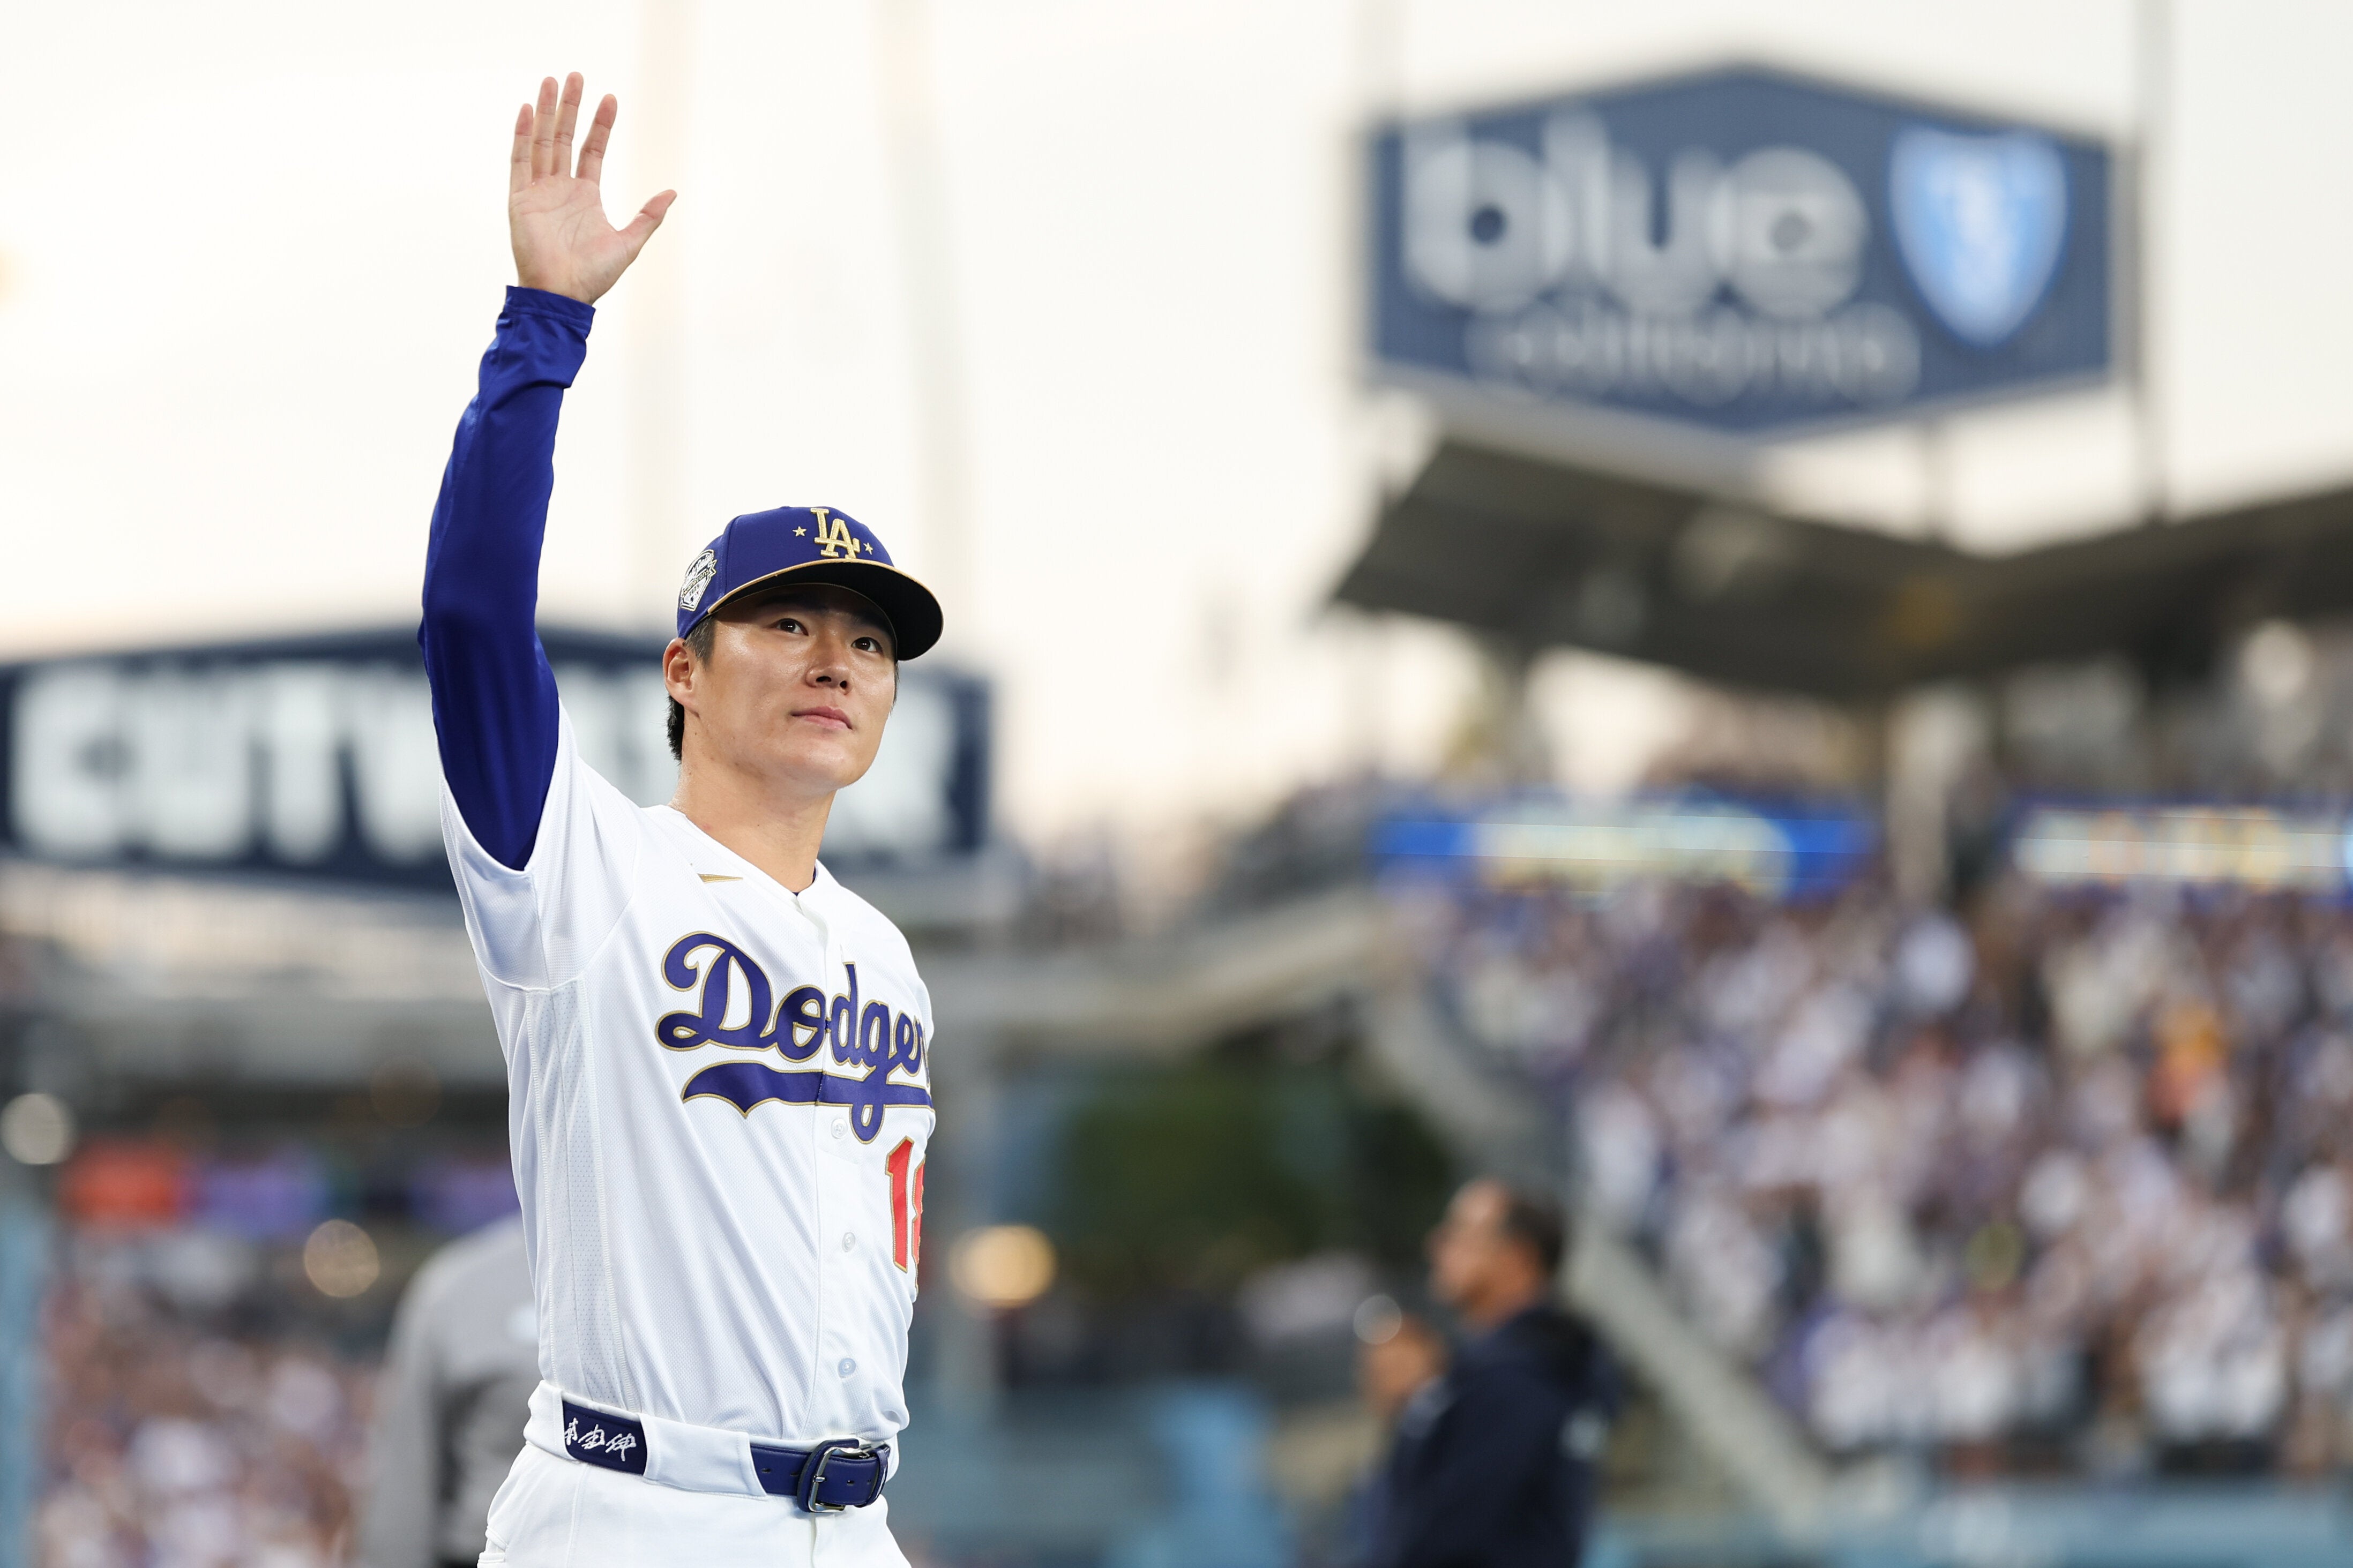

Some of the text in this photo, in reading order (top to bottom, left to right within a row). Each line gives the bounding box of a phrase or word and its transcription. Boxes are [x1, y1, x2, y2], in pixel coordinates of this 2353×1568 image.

[1402, 111, 1867, 315] blue
[810, 508, 860, 559] LA
[655, 931, 932, 1144] Dodge
